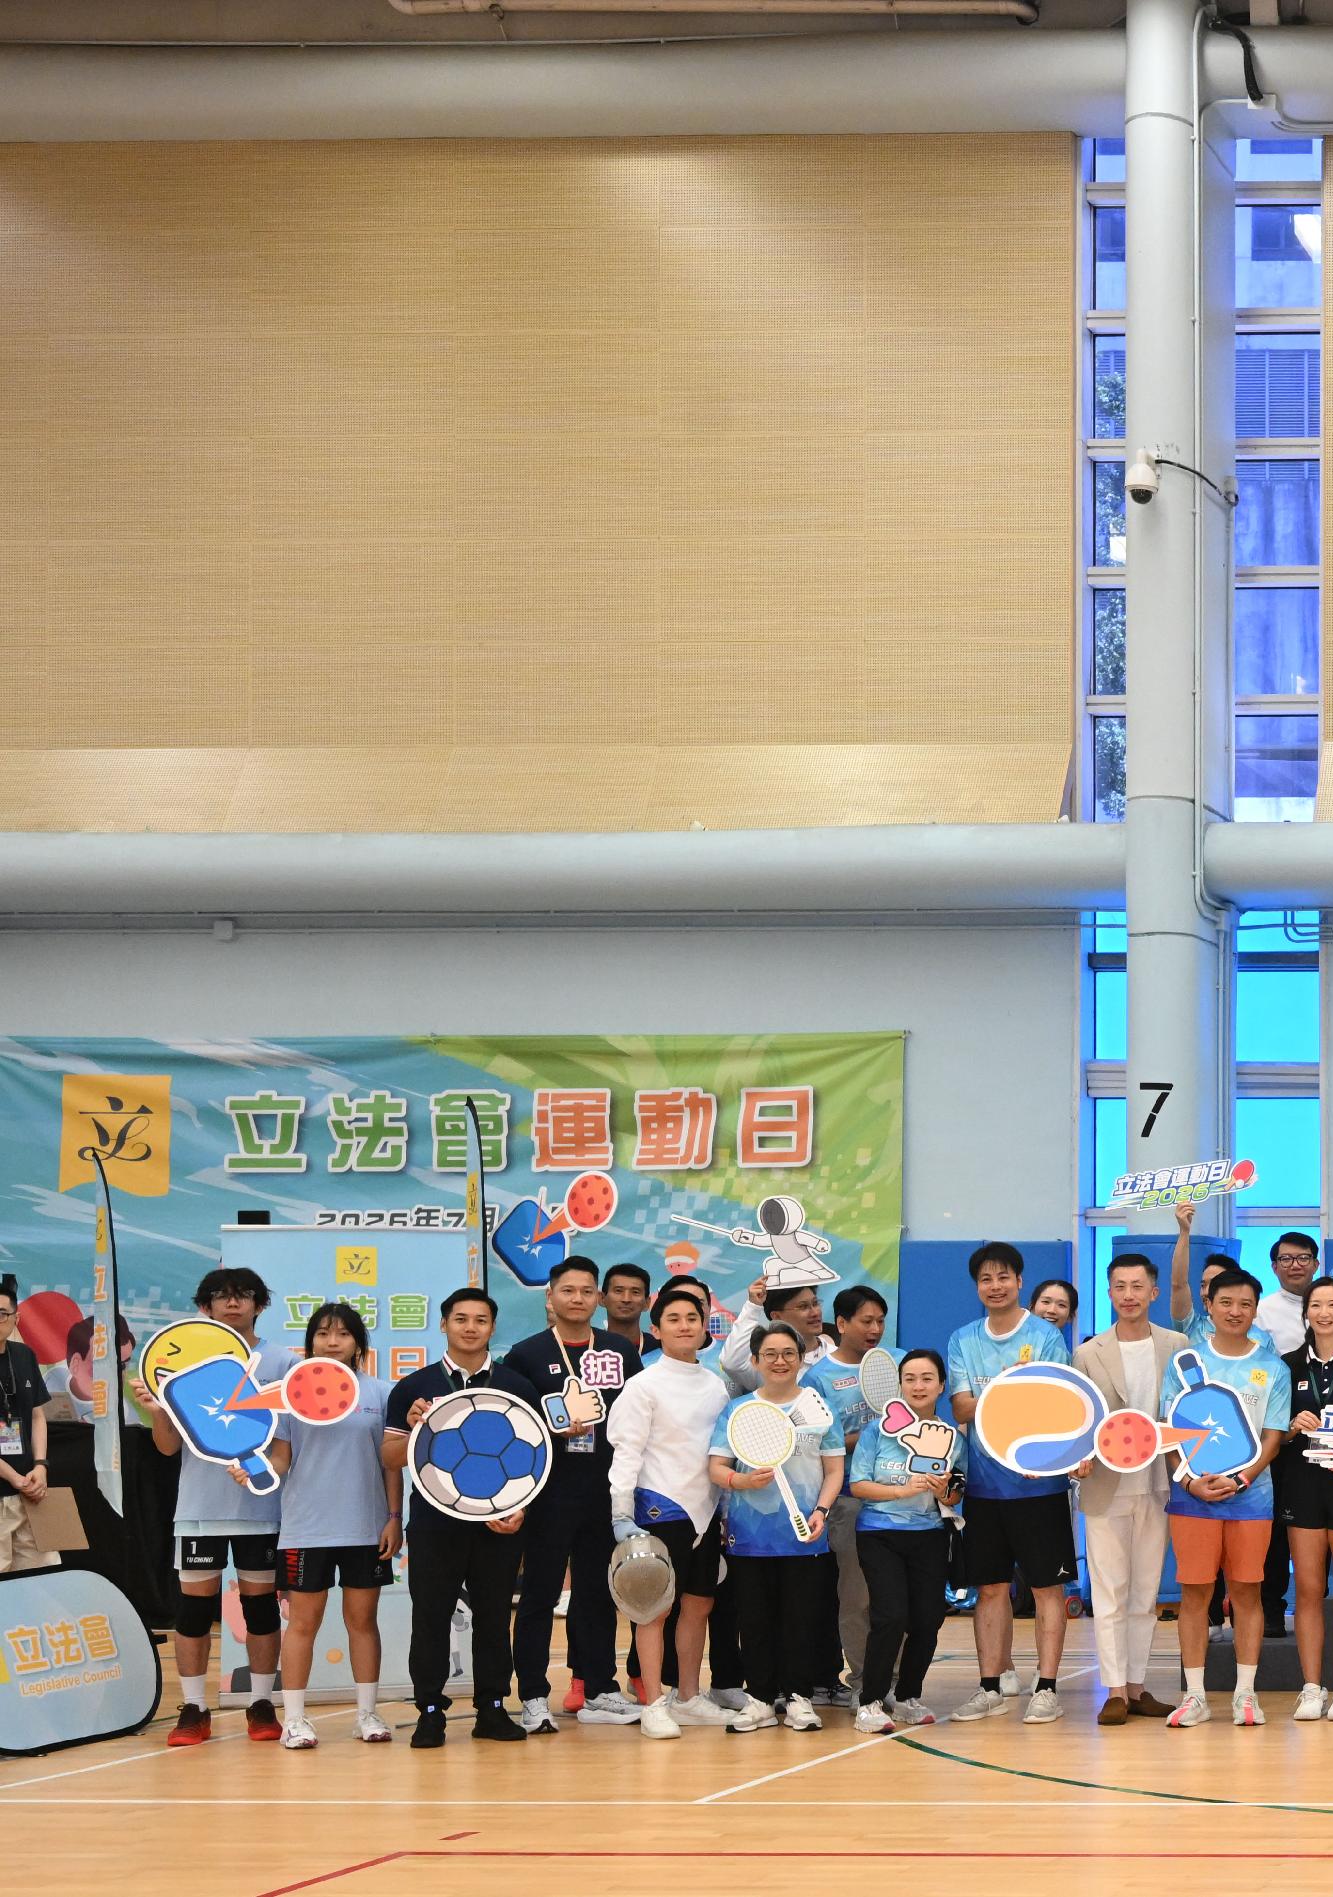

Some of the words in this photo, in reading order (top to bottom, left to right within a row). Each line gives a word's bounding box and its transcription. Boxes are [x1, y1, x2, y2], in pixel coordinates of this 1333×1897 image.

[1139, 1083, 1174, 1138] 7
[225, 1088, 813, 1173] 立法會運動日
[1114, 1160, 1229, 1195] 立法會運動日
[1140, 1183, 1210, 1208] 2026
[581, 1351, 623, 1388] 掂
[189, 1541, 197, 1554] 1
[5, 1614, 118, 1674] 立法會
[20, 1674, 81, 1697] Legislative
[83, 1664, 122, 1684] Council
